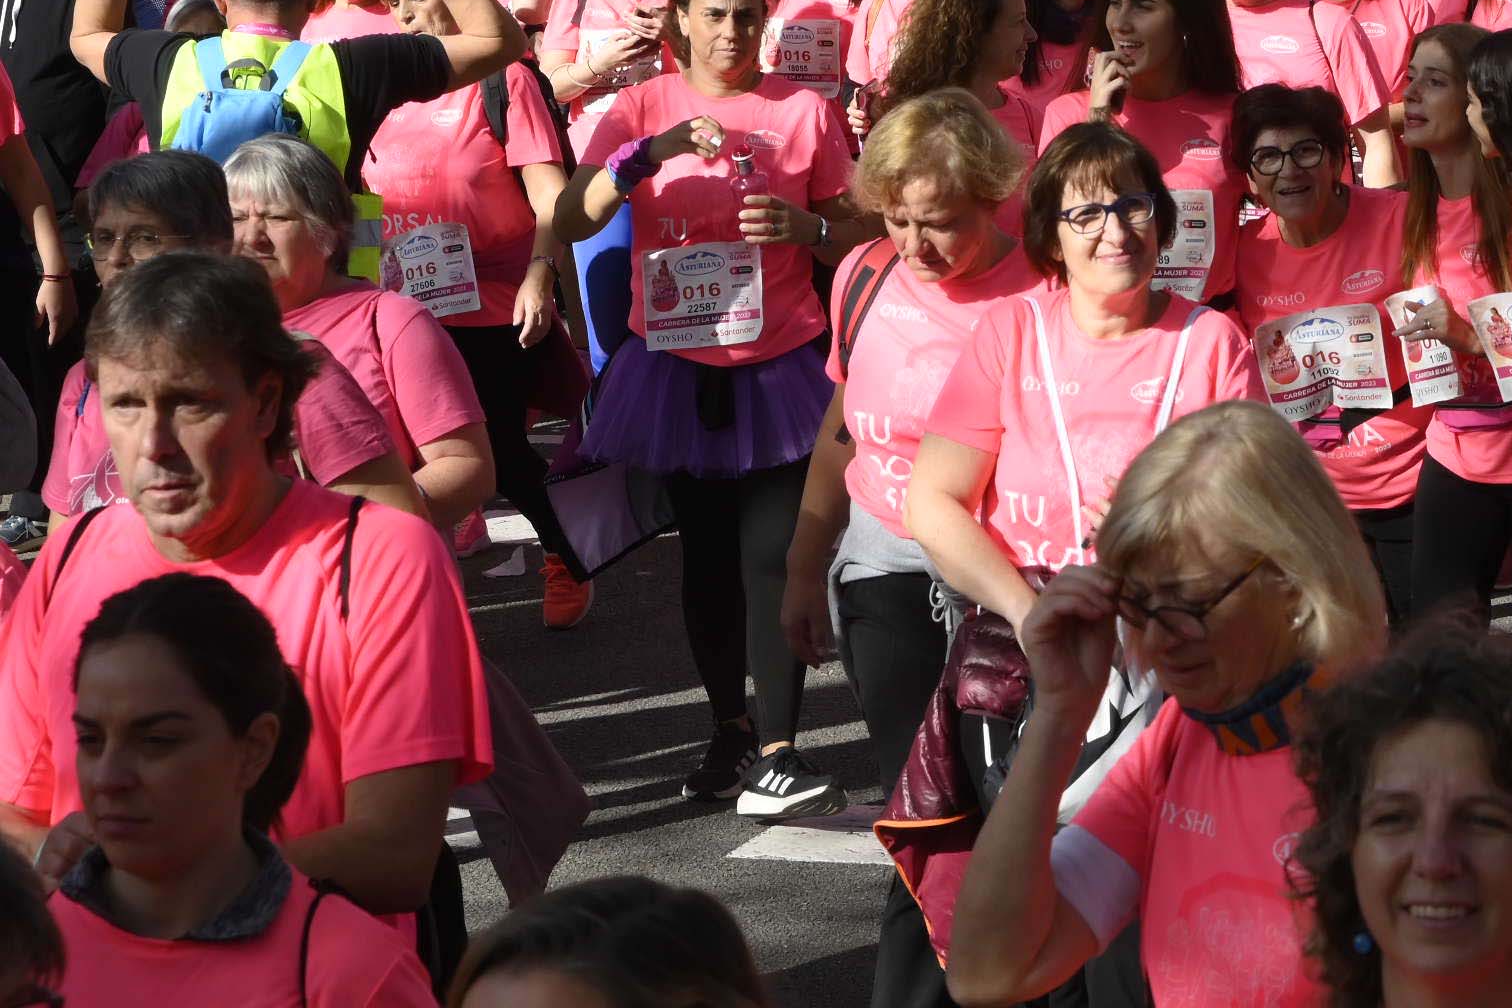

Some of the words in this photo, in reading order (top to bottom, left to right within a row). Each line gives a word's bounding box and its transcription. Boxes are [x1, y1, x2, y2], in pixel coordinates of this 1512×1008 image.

[784, 50, 811, 62] 016
[678, 259, 721, 272] ASTURIANA
[1158, 255, 1170, 265] 89
[405, 261, 437, 281] 016
[1346, 275, 1383, 291] ASTURIANA
[682, 282, 721, 300] 016
[1257, 292, 1305, 306] OYSHO
[687, 302, 717, 313] 22587
[1348, 318, 1373, 326] SUMA
[656, 333, 693, 344] OYSHO
[1296, 327, 1341, 340] ASTURIANA
[1301, 350, 1341, 369] 016
[1311, 367, 1340, 380] 11092
[1283, 386, 1316, 401] CARRERA
[1317, 381, 1327, 390] DE
[1328, 379, 1336, 387] LA
[1336, 379, 1358, 388] MUJER
[1344, 393, 1383, 402] Santander
[1284, 399, 1321, 416] OYSHO
[853, 411, 891, 445] TU
[1004, 491, 1044, 528] TU
